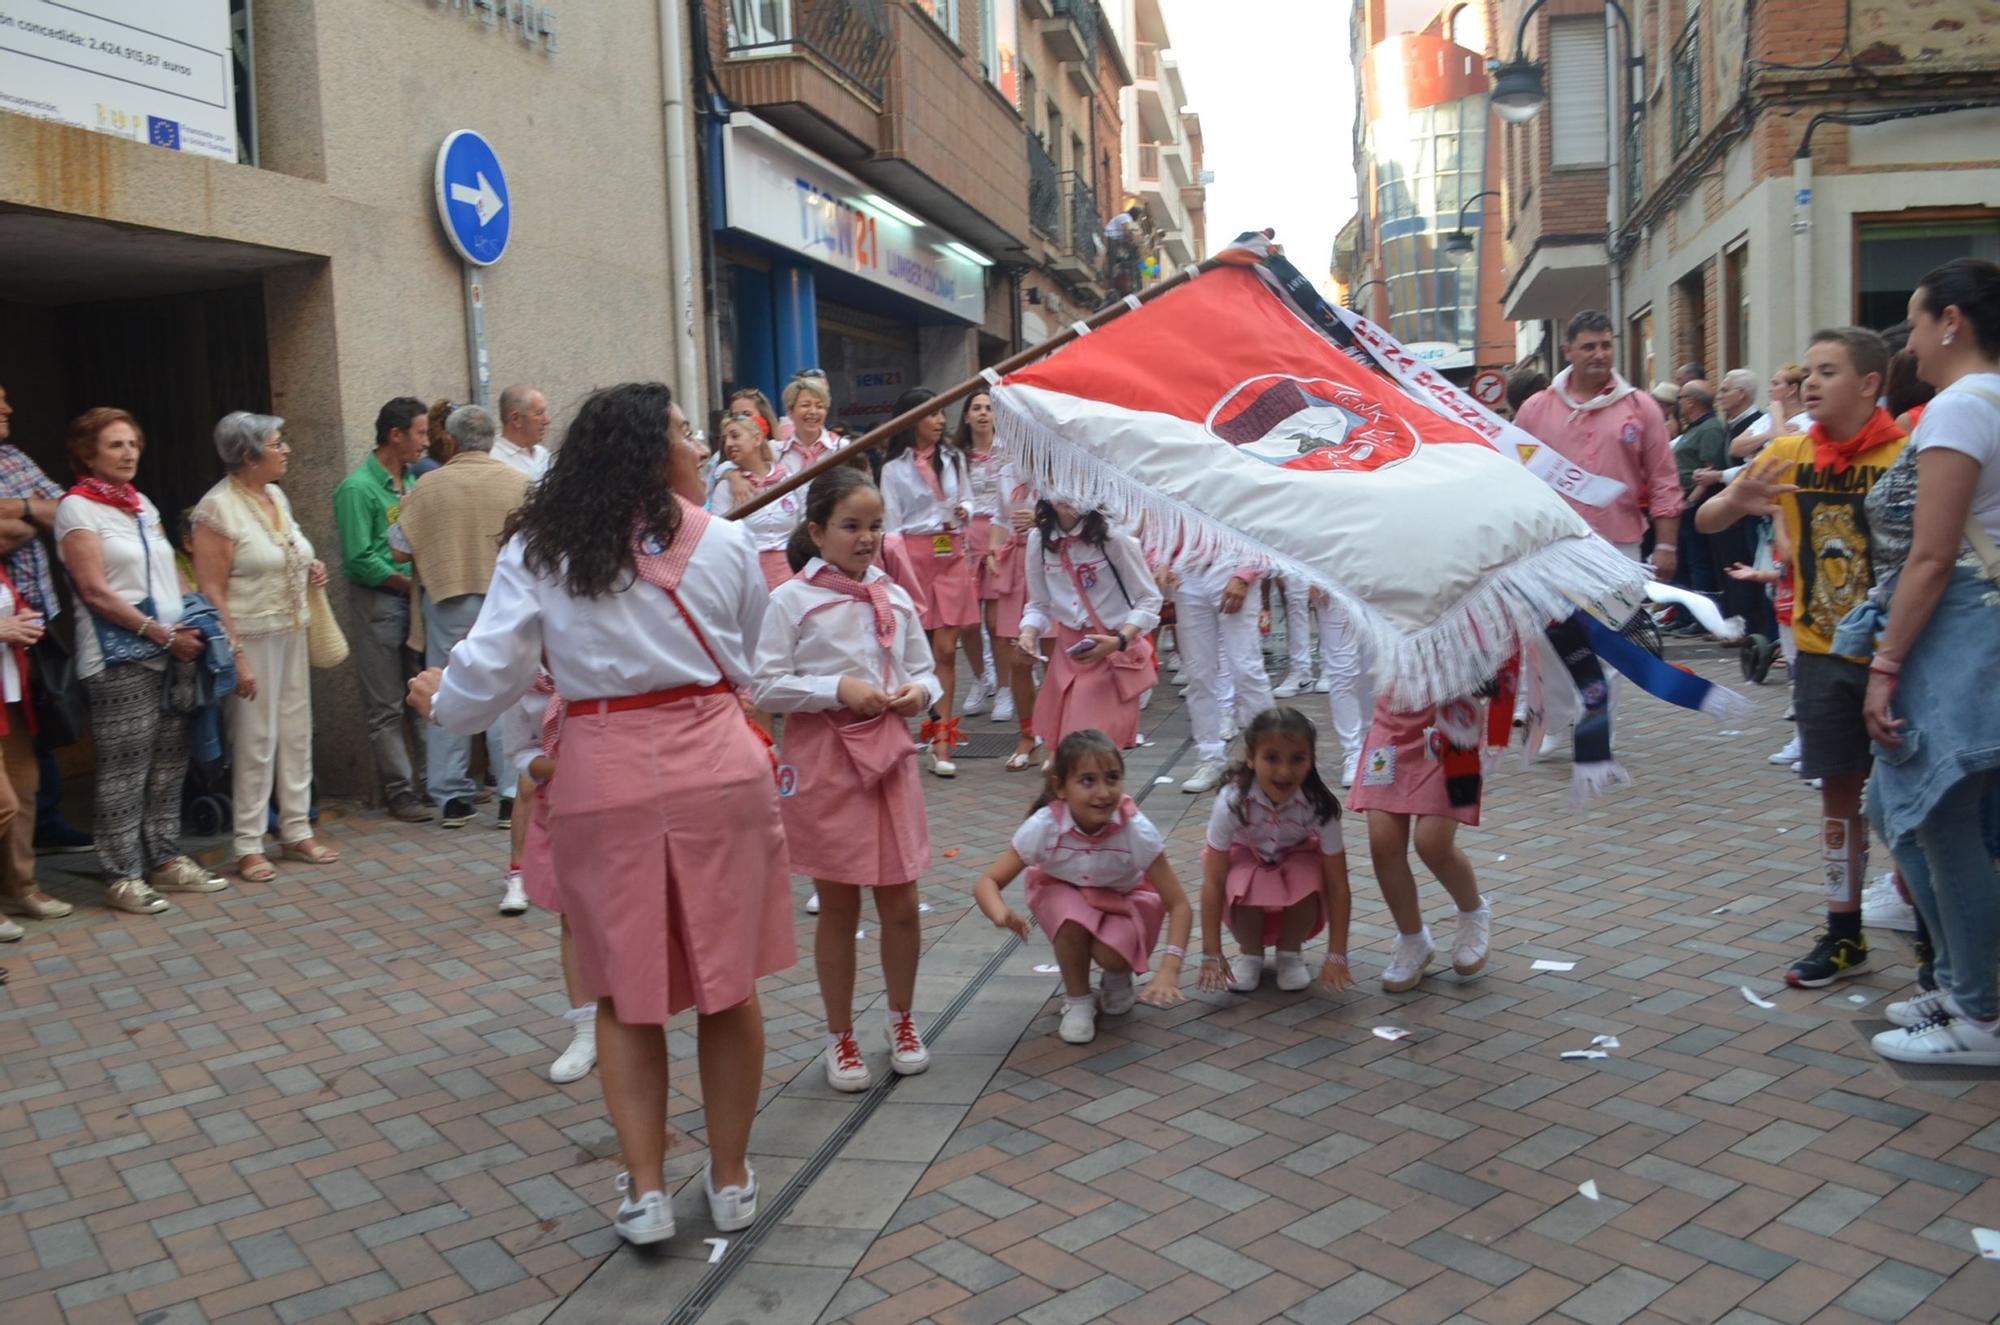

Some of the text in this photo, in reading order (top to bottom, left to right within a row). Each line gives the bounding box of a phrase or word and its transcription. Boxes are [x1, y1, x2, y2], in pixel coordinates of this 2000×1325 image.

[17, 20, 84, 46] concedida:
[89, 38, 160, 66] 2.424.915,87
[162, 59, 192, 76] euros
